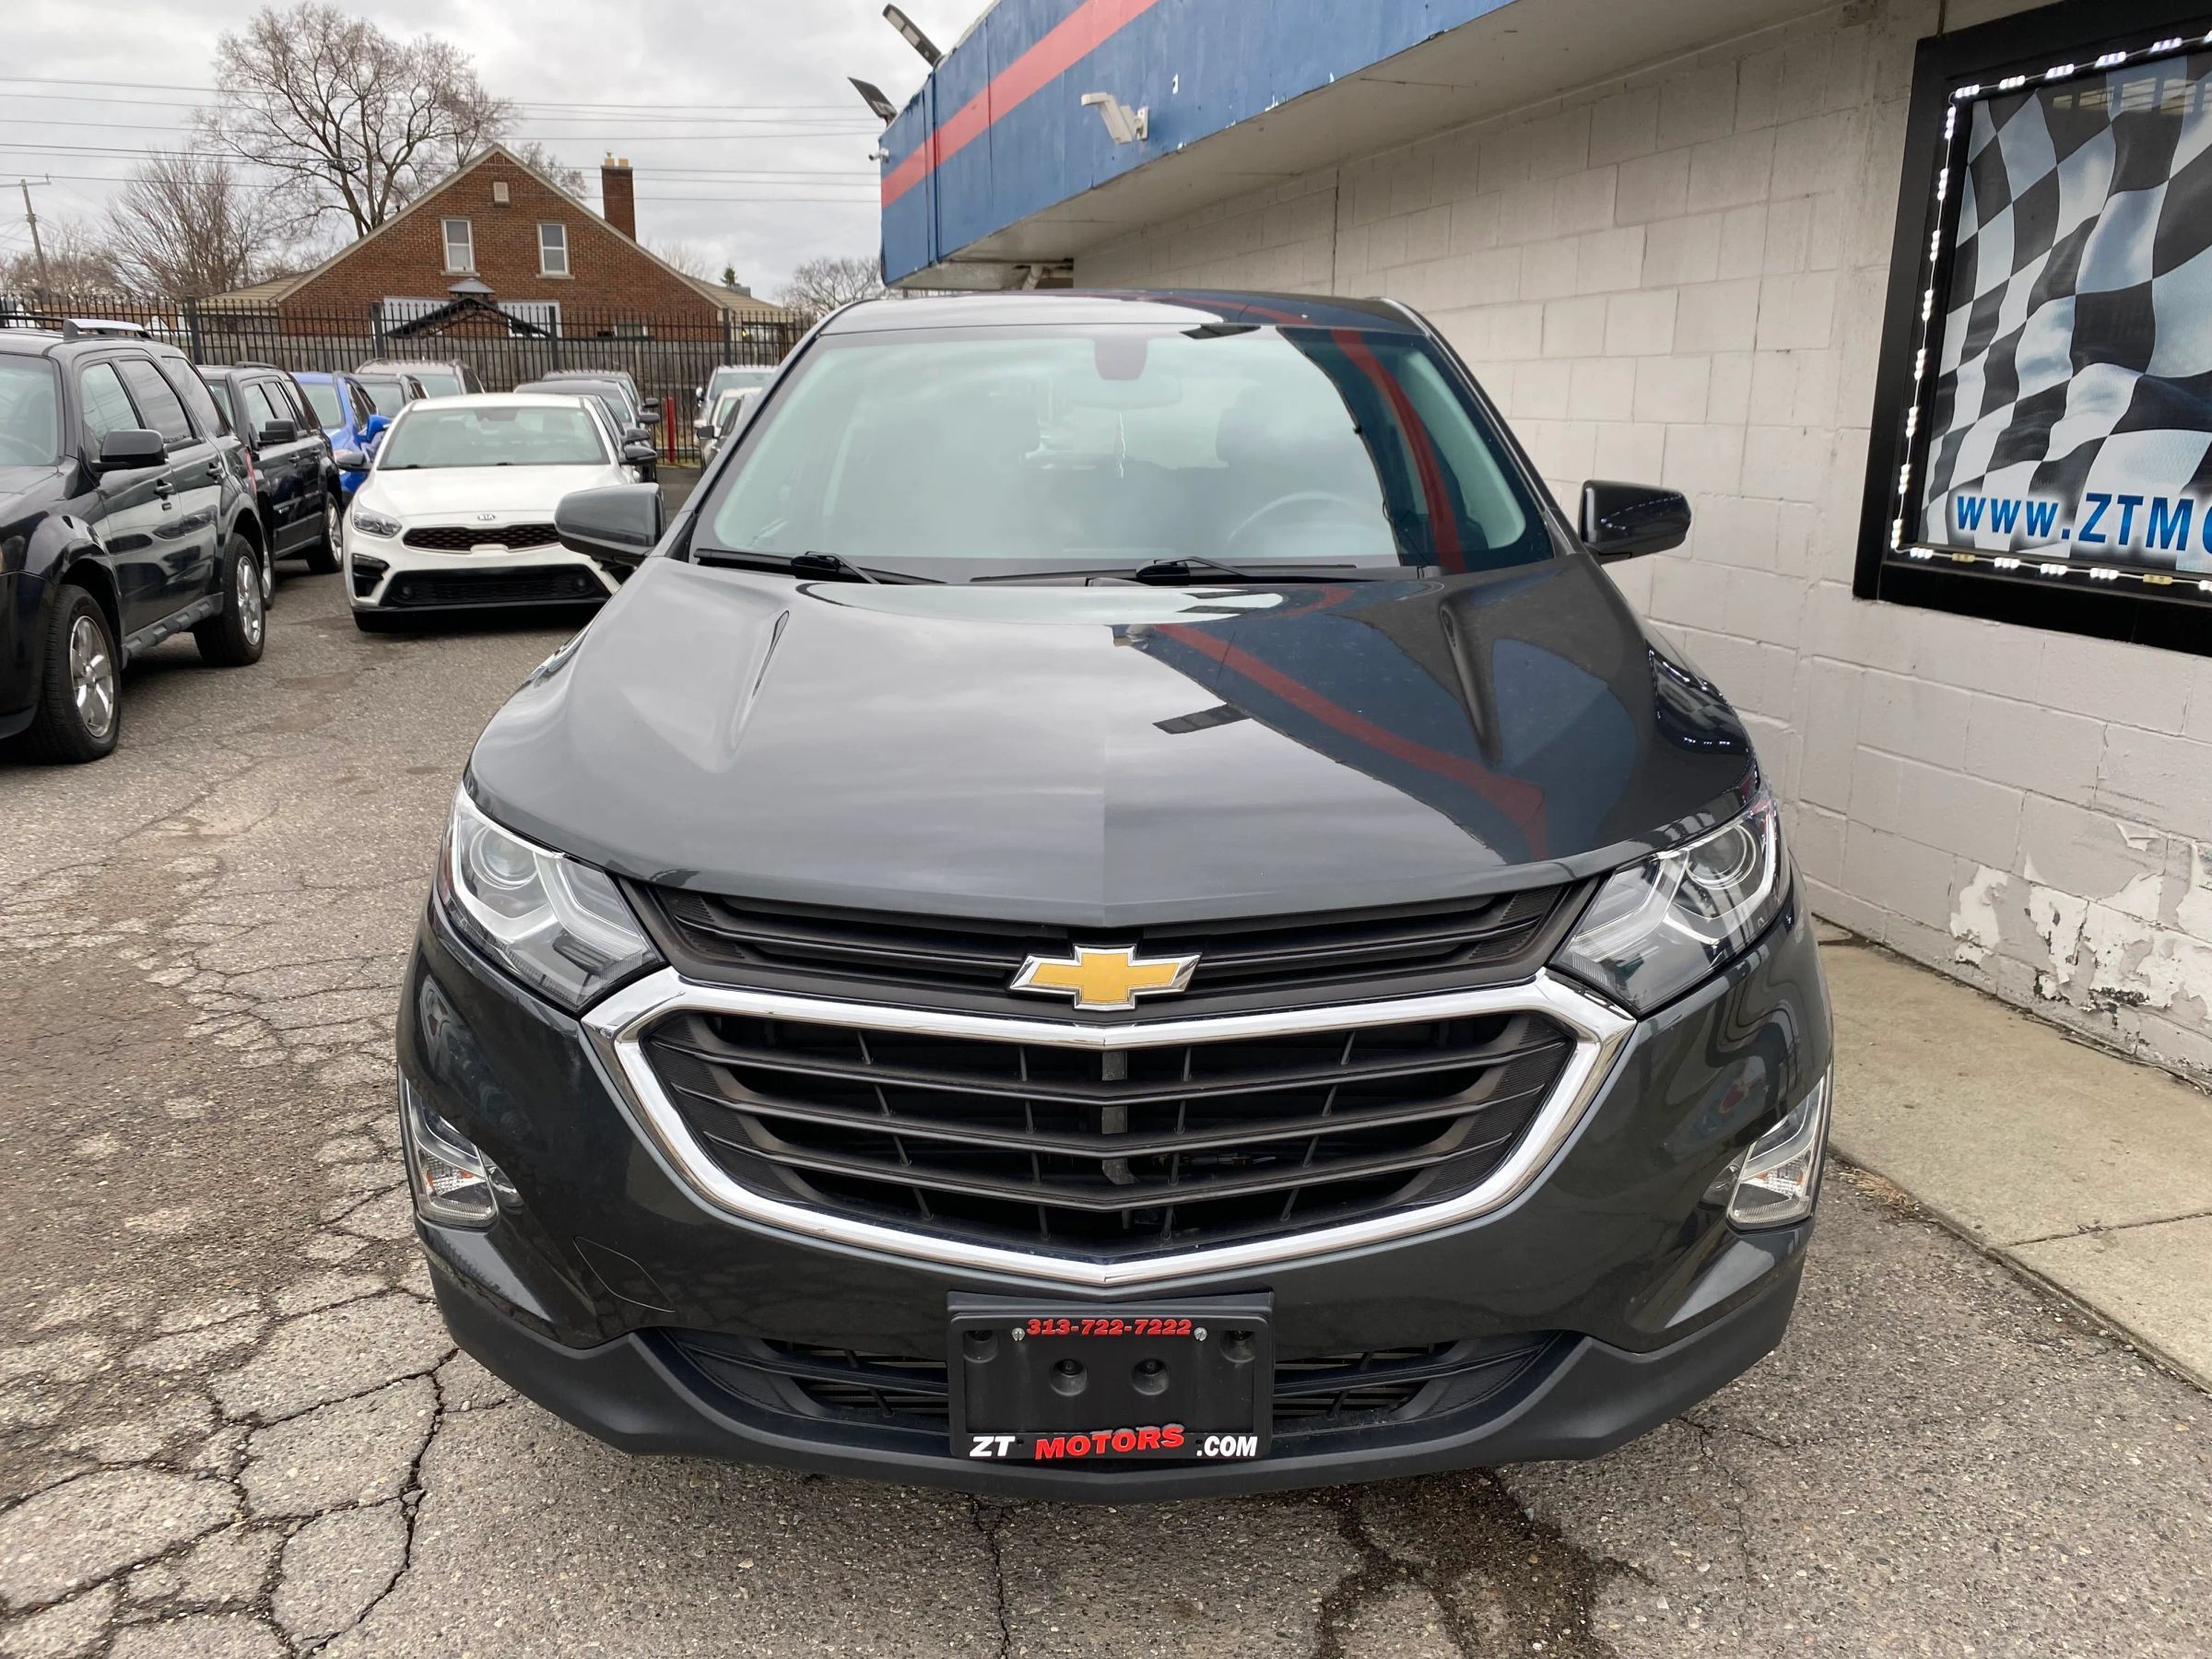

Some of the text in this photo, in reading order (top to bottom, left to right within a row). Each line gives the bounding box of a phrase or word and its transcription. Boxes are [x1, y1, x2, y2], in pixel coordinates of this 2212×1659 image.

[1957, 492, 2212, 555] WWW.ZTM
[1026, 1319, 1192, 1336] 313-722-7222
[969, 1424, 1258, 1460] ZT MOTORS .COM
